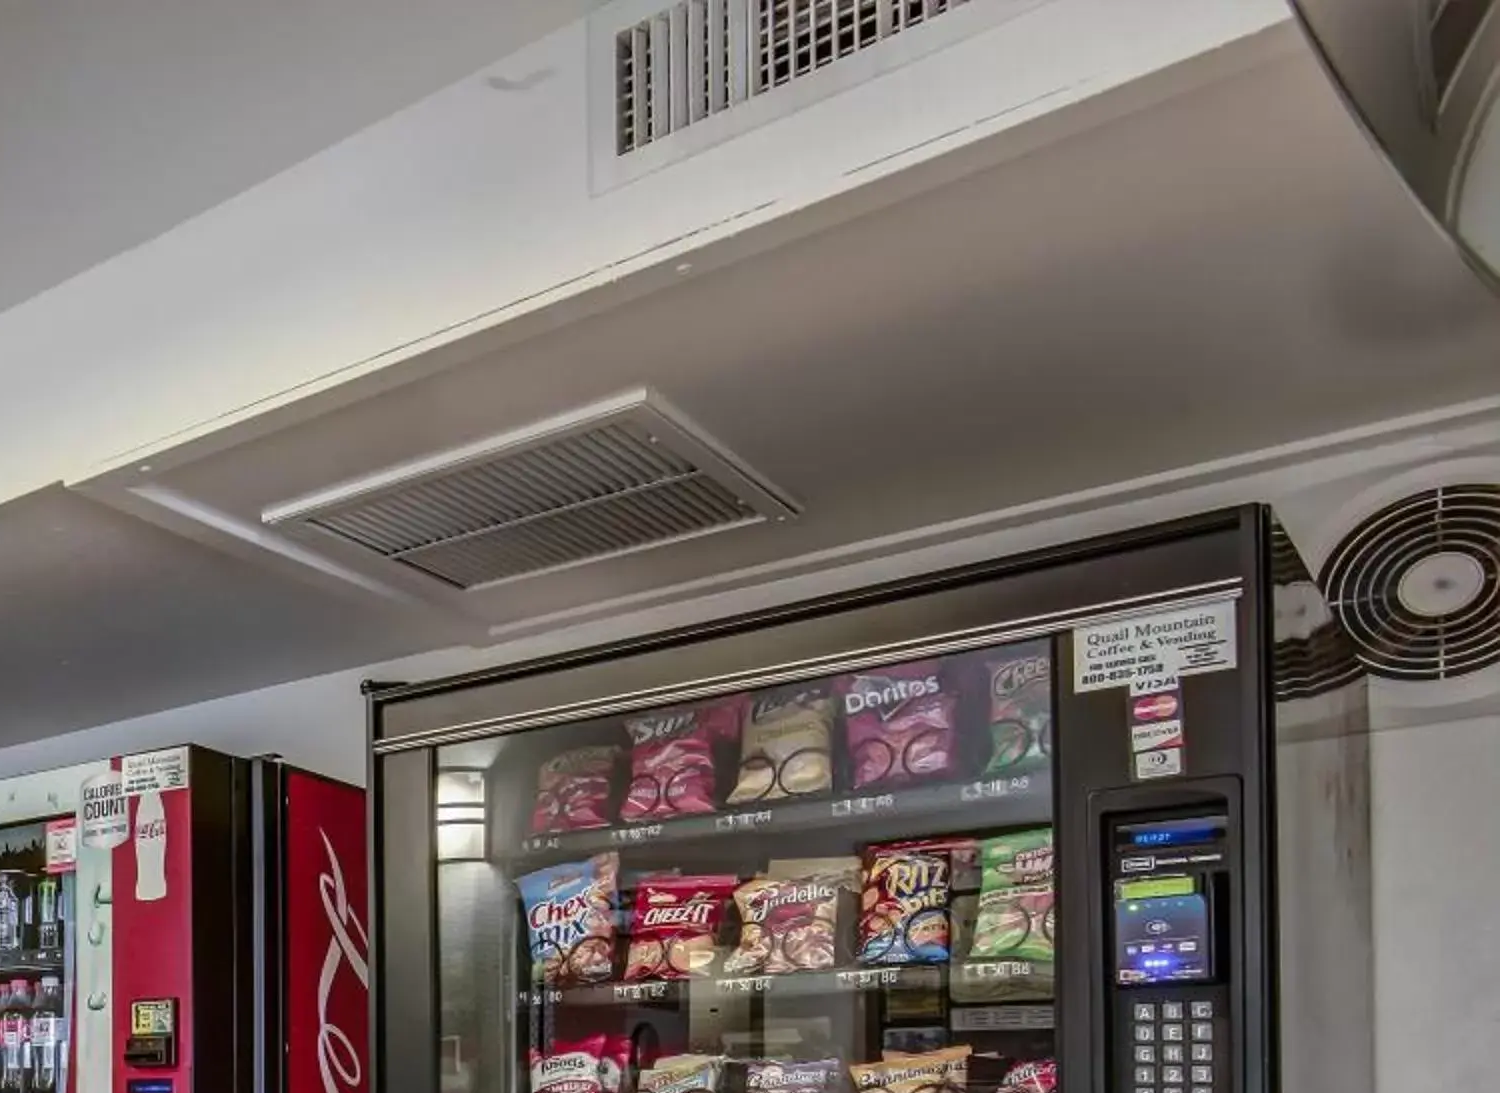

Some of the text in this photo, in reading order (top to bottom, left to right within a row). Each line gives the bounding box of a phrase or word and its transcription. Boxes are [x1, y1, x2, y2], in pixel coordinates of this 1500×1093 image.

[1086, 629, 1217, 659] Coffee & Vending
[1087, 613, 1216, 647] Quail Mountain
[844, 674, 941, 714] Doritos
[1135, 676, 1177, 691] VISA
[83, 798, 125, 821] COUNT
[887, 859, 949, 896] RITZ
[529, 888, 593, 929] Chex
